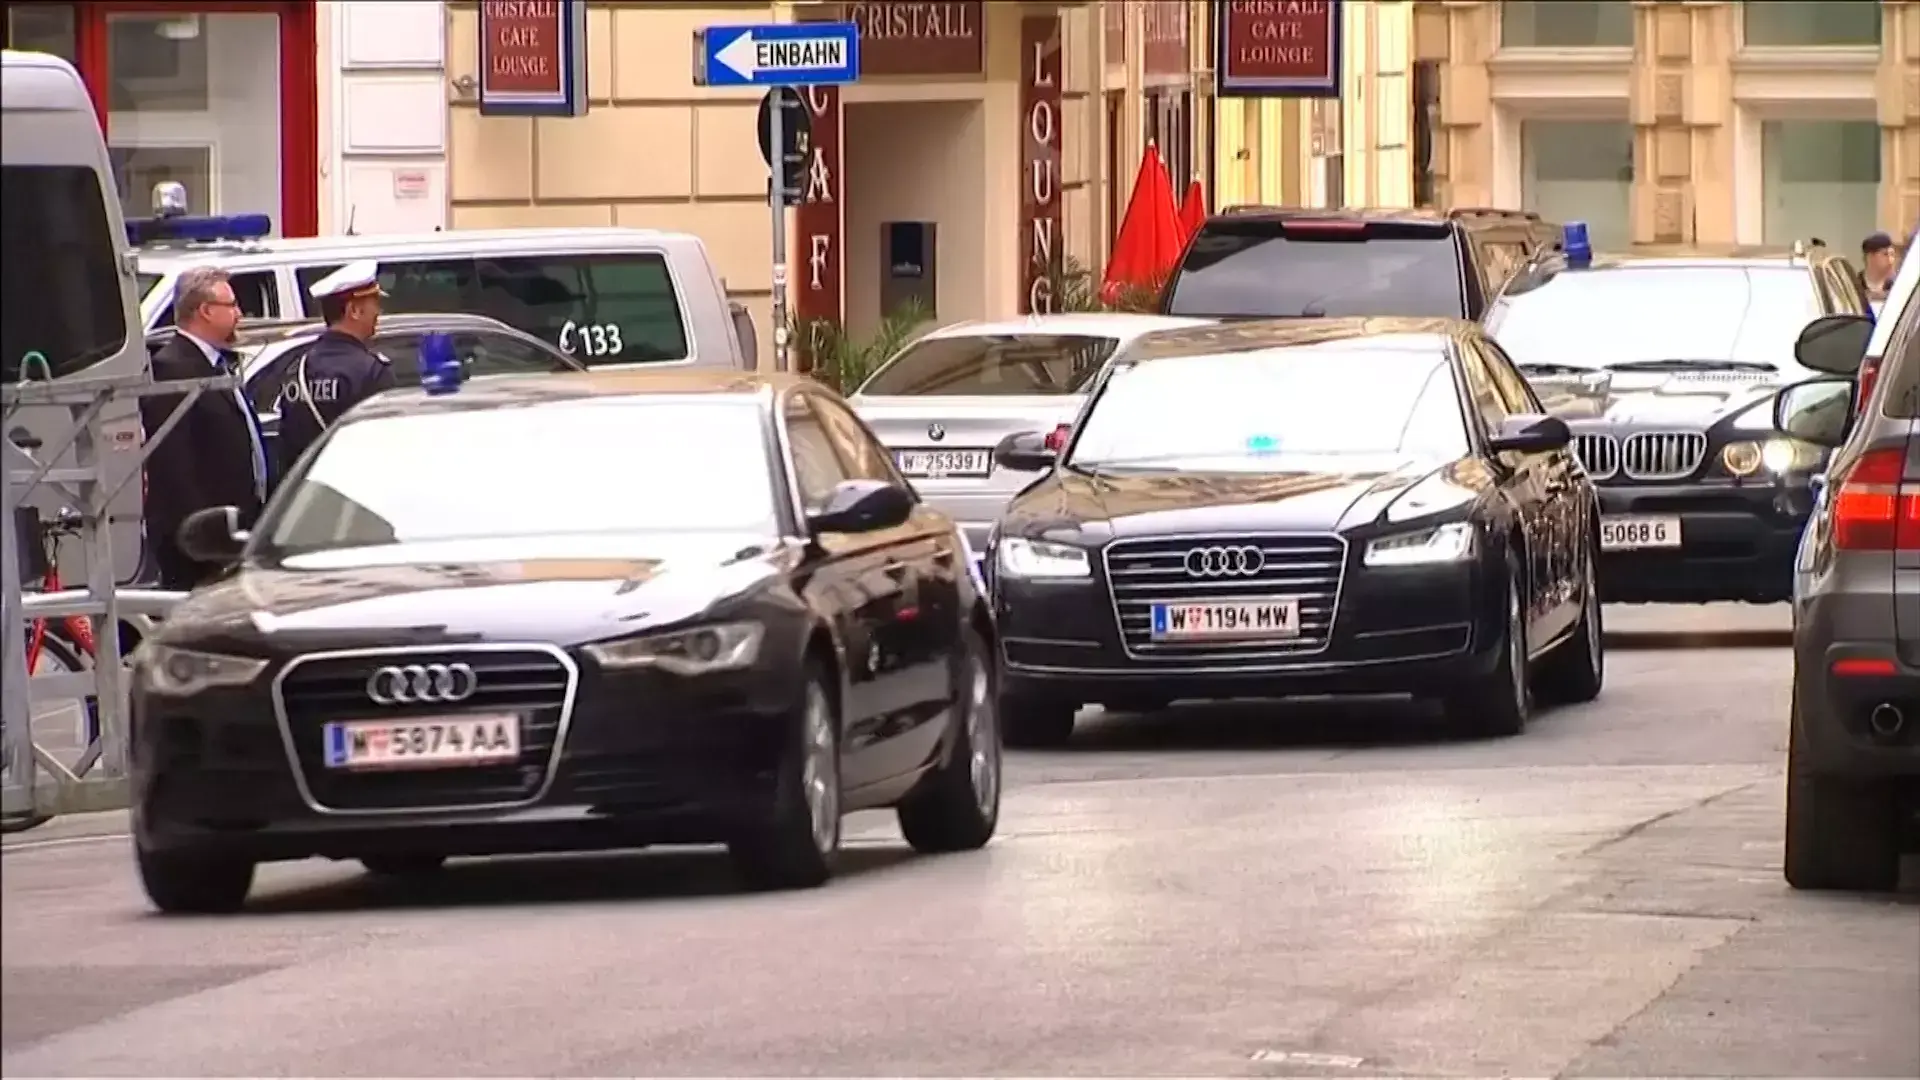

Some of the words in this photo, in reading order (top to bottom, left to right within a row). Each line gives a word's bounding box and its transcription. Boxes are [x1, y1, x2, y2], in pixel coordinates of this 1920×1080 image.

[486, 1, 556, 18] CRISTALL
[1231, 1, 1324, 15] CRISTALL
[851, 4, 972, 39] CRISTALL
[1250, 20, 1304, 40] CAFE
[500, 27, 540, 47] CAFE
[756, 41, 841, 68] EINBAHN
[1239, 45, 1315, 64] LOUNGE
[493, 55, 549, 76] LOUNGE
[578, 323, 623, 356] 133
[1603, 523, 1650, 543] 5068
[1654, 523, 1666, 542] G
[1170, 607, 1187, 630] W
[1204, 606, 1250, 629] 1194
[1257, 605, 1289, 628] MW
[391, 725, 465, 755] 5874
[471, 722, 511, 751] AA
